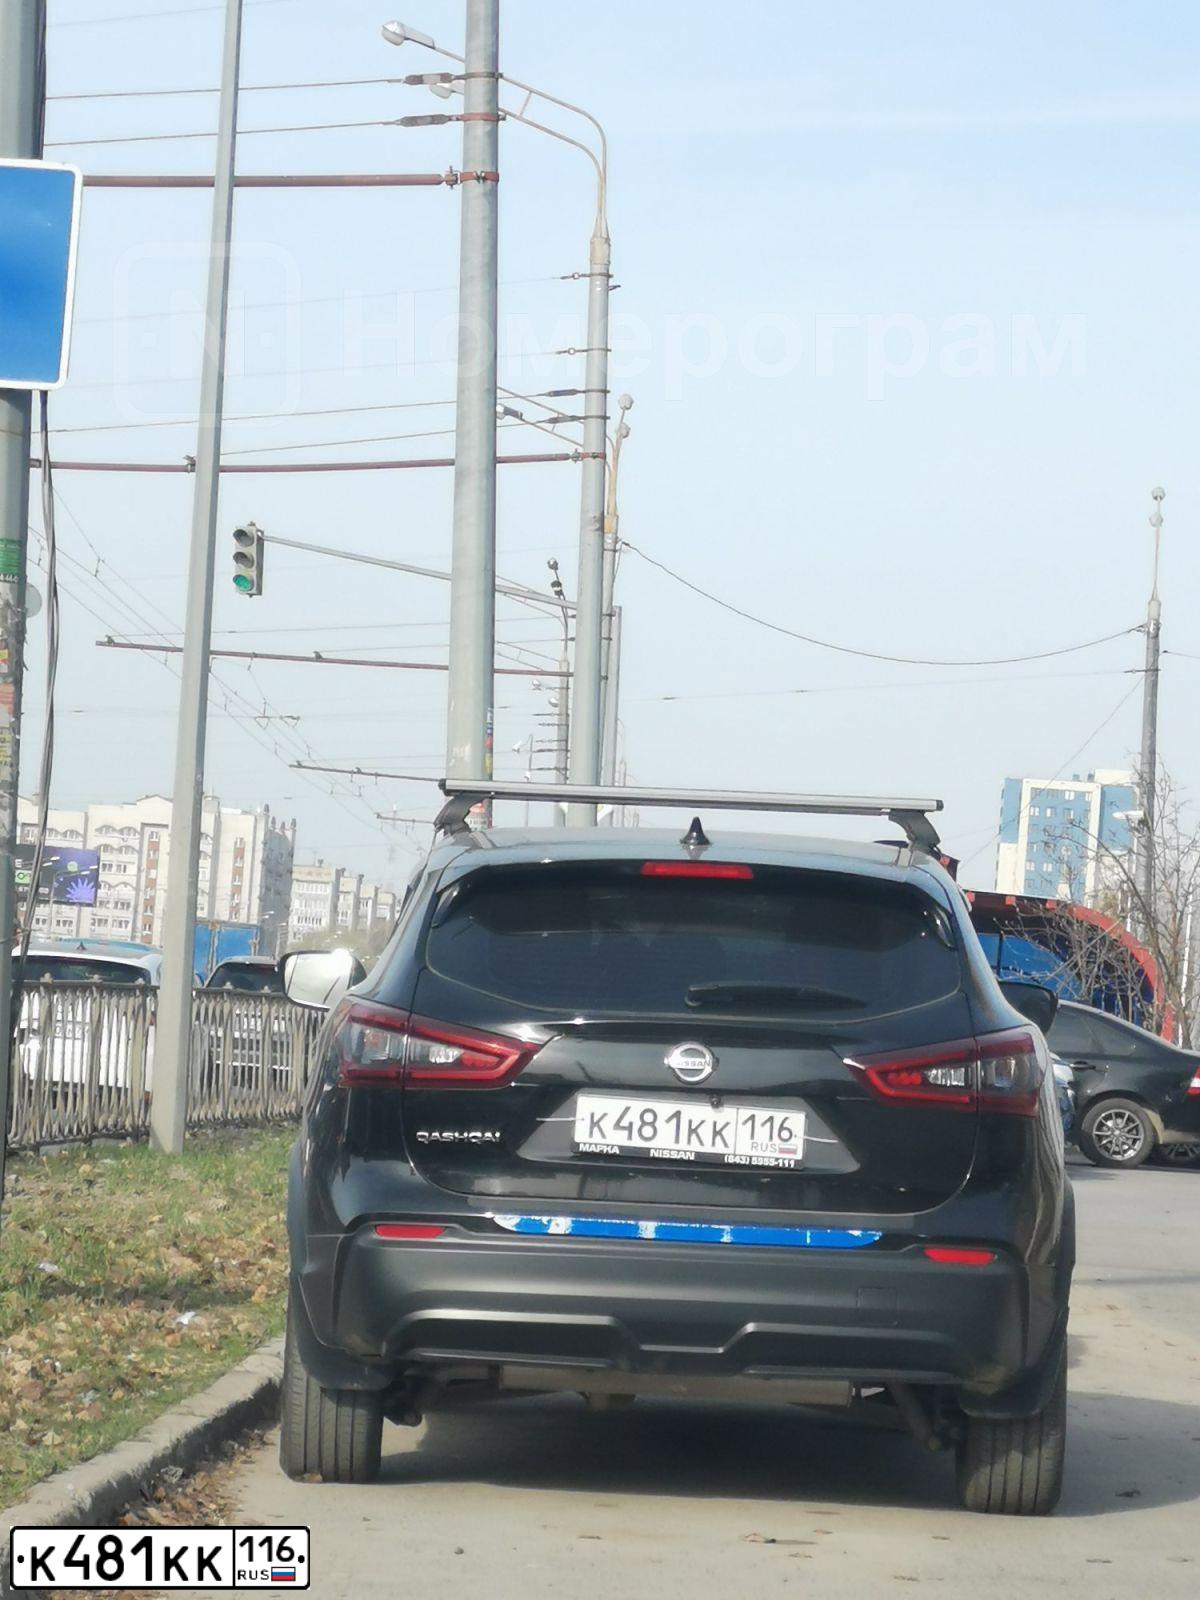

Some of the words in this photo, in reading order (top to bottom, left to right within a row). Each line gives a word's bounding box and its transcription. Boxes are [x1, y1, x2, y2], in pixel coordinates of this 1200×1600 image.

[587, 1106, 731, 1149] К481КК
[741, 1113, 793, 1143] 116
[416, 1131, 500, 1144] QASHQAI
[751, 1141, 777, 1154] RUS
[649, 1148, 696, 1161] NISSAN
